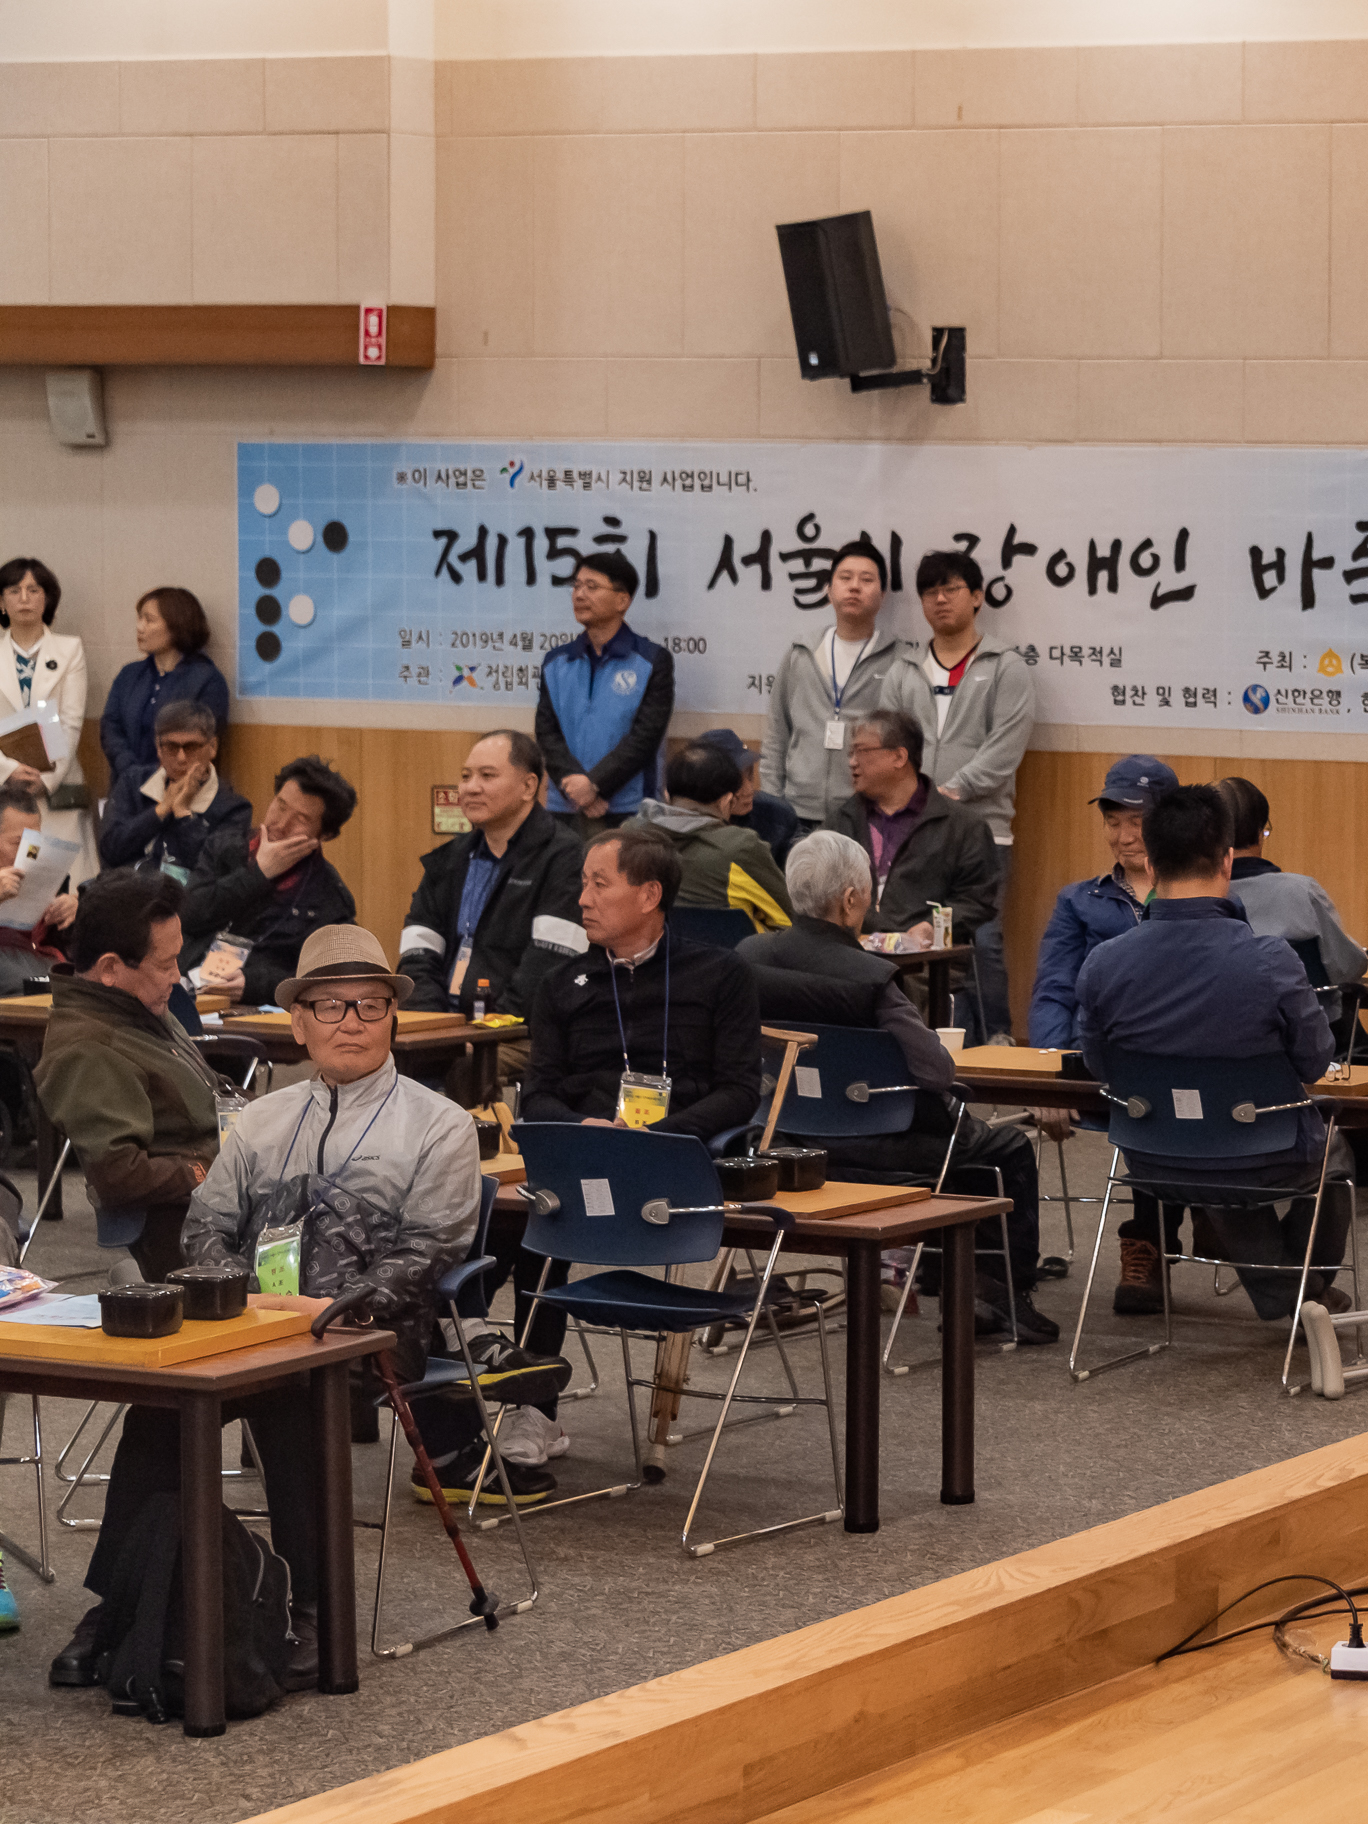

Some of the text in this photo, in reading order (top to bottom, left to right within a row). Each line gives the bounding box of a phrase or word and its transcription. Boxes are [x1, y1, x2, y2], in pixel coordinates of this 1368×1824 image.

[435, 467, 486, 490] 사업은
[528, 469, 610, 491] 서울특별시
[618, 469, 652, 492] 지원
[660, 469, 758, 493] 사업입니다.
[952, 522, 1197, 611] 장애인
[399, 628, 430, 649] 일시
[450, 630, 504, 651] 2019년
[509, 631, 534, 652] 4월
[1049, 645, 1123, 668] 다목적실
[1255, 650, 1293, 672] 주최
[399, 664, 430, 685] 주관
[1110, 684, 1147, 706] 협찬
[1156, 685, 1172, 707] 및
[1181, 687, 1218, 708] 협력
